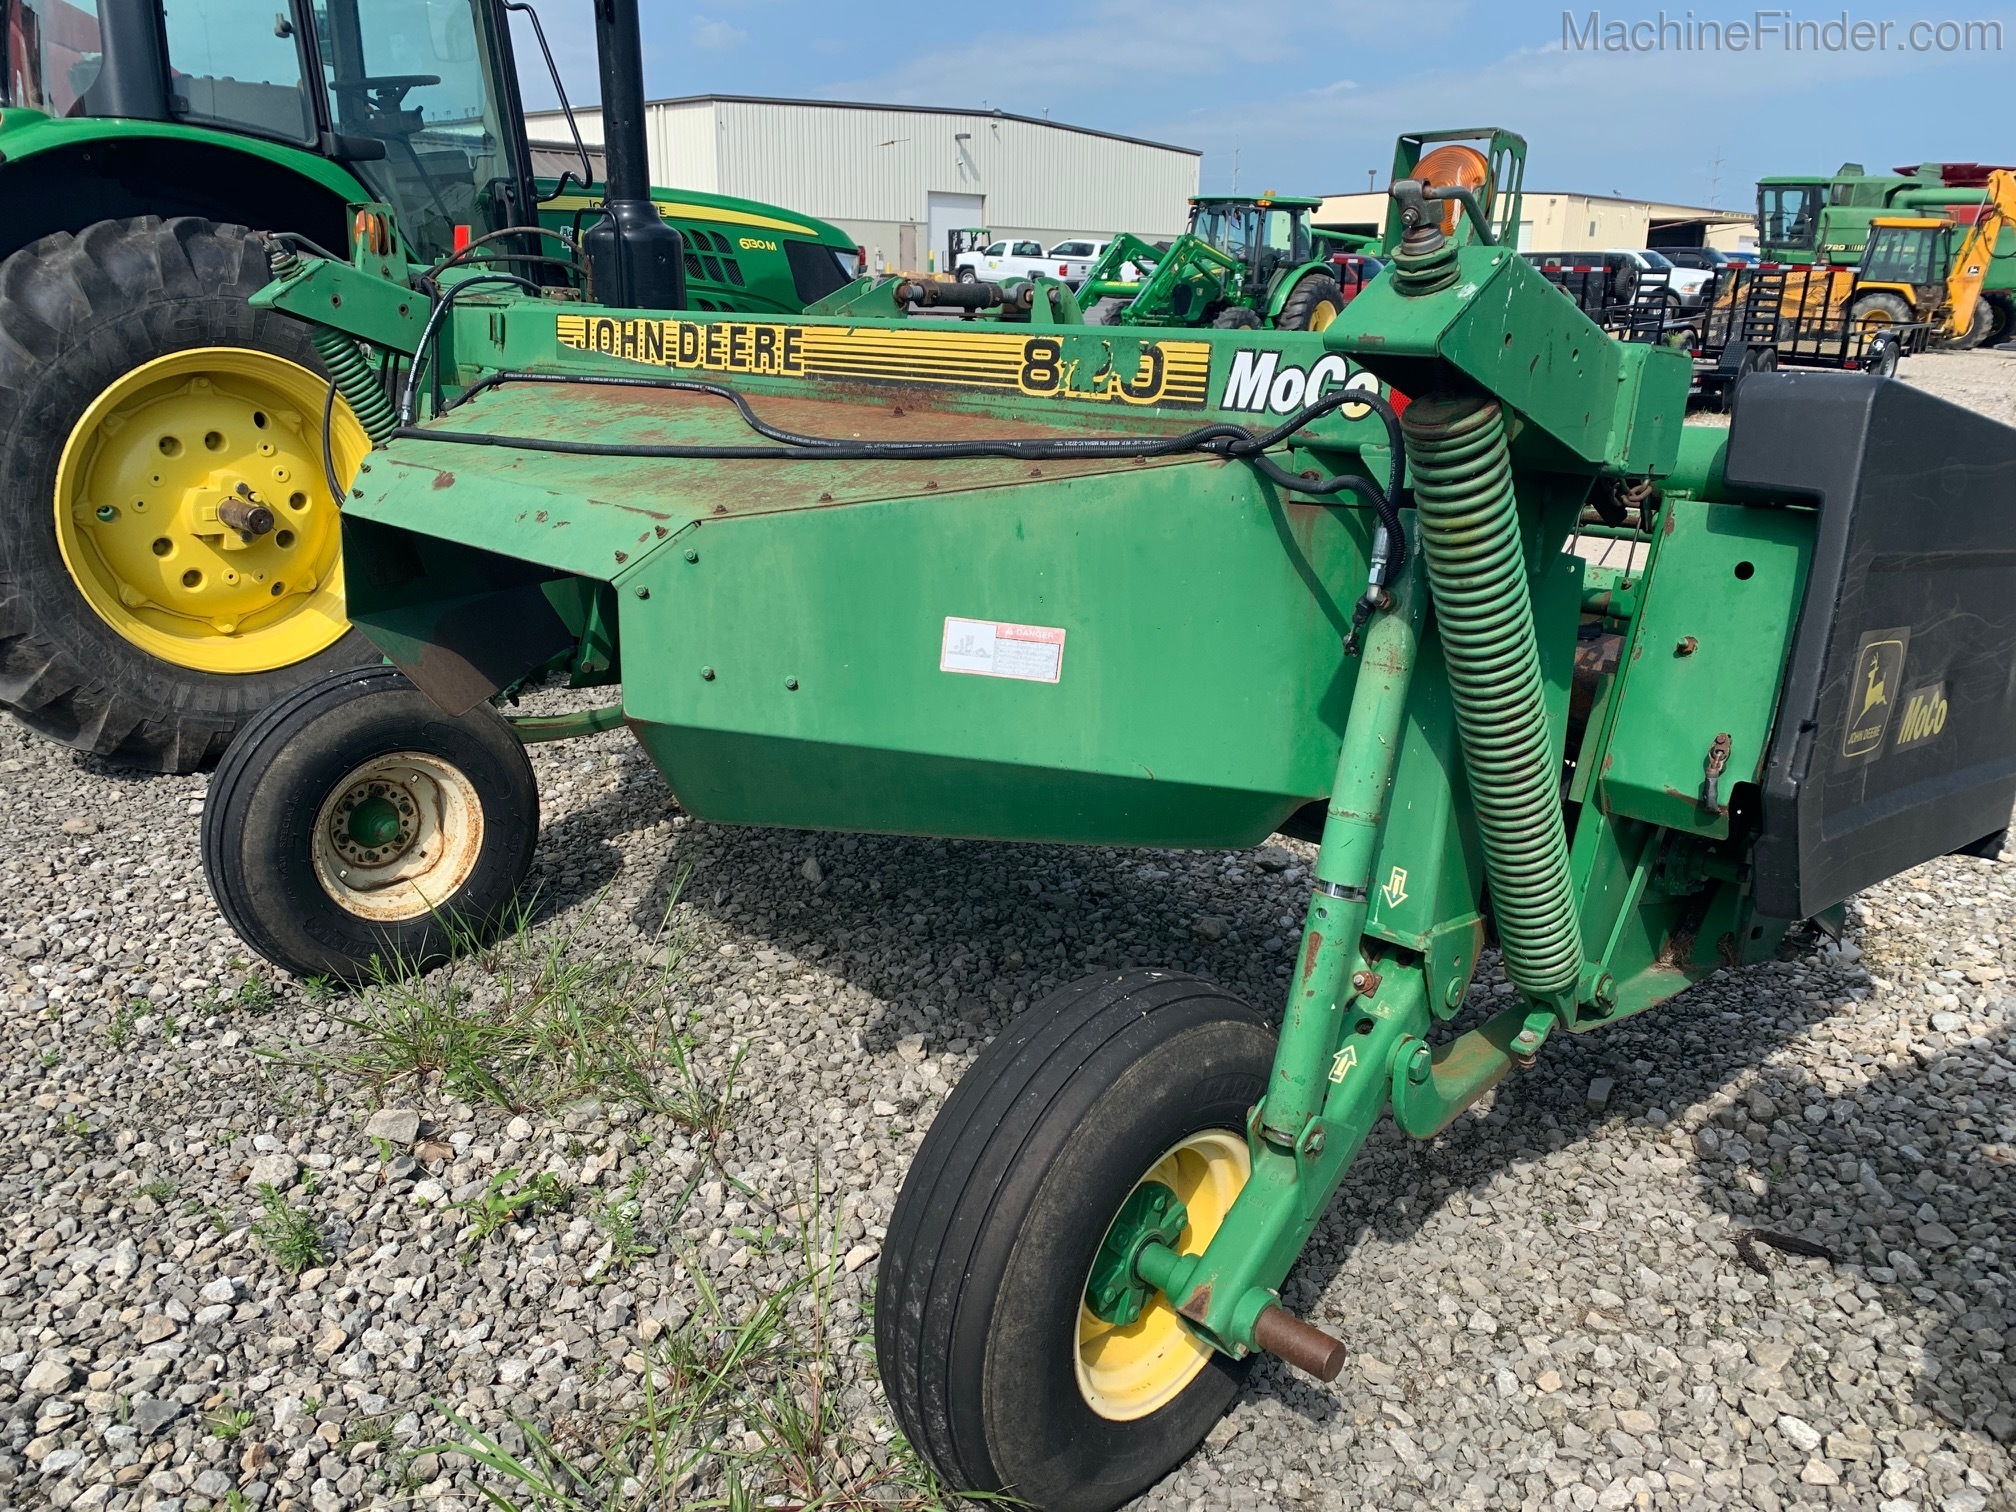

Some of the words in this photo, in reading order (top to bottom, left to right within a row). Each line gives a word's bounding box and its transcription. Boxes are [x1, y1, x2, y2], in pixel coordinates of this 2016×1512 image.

[577, 318, 664, 361] JOHN
[679, 322, 803, 371] DEERE
[1221, 350, 1381, 420] MoCo
[1015, 628, 1055, 639] DANGER
[1847, 729, 1864, 745] JOHN
[1863, 724, 1882, 741] DEERE
[1897, 690, 1948, 745] MoCo
